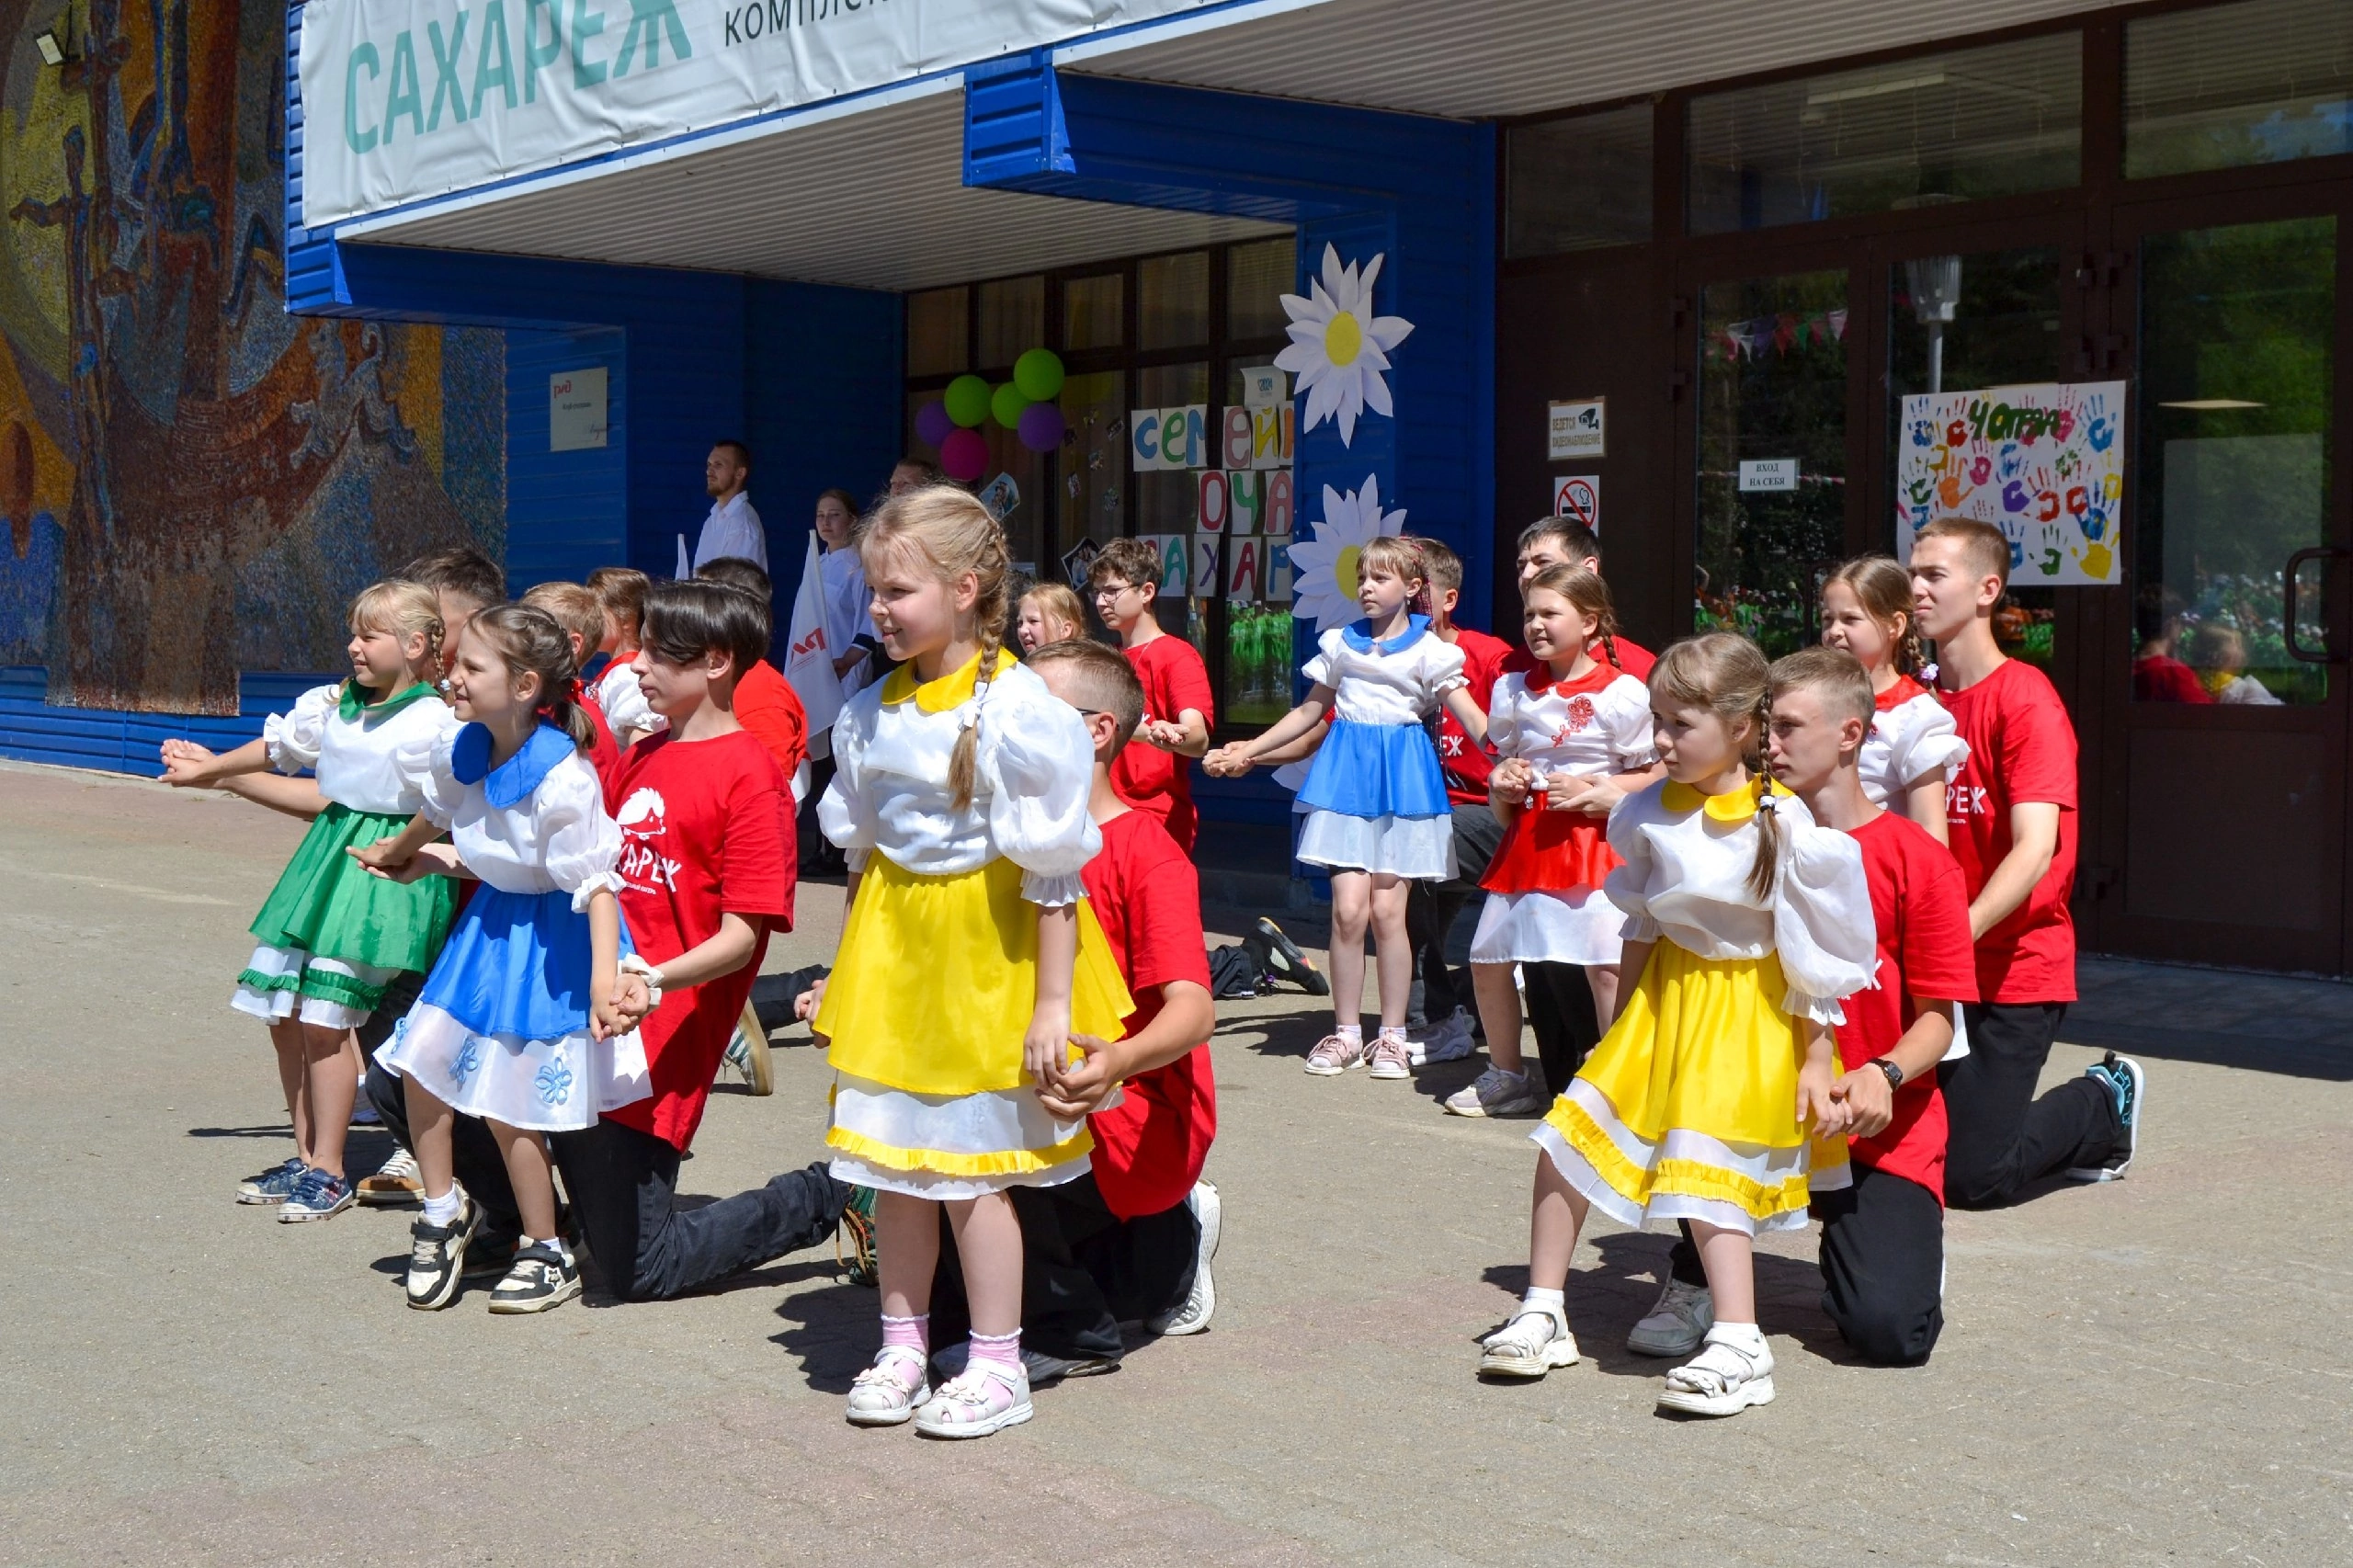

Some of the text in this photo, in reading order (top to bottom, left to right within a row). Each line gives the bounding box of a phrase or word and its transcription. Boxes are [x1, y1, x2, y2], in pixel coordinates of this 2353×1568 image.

[346, 0, 692, 154] САХАРЕЖ
[1749, 477, 1785, 486] НА СЕБЯ
[1756, 463, 1779, 472] ВХОД
[1144, 536, 1290, 594] АХАР
